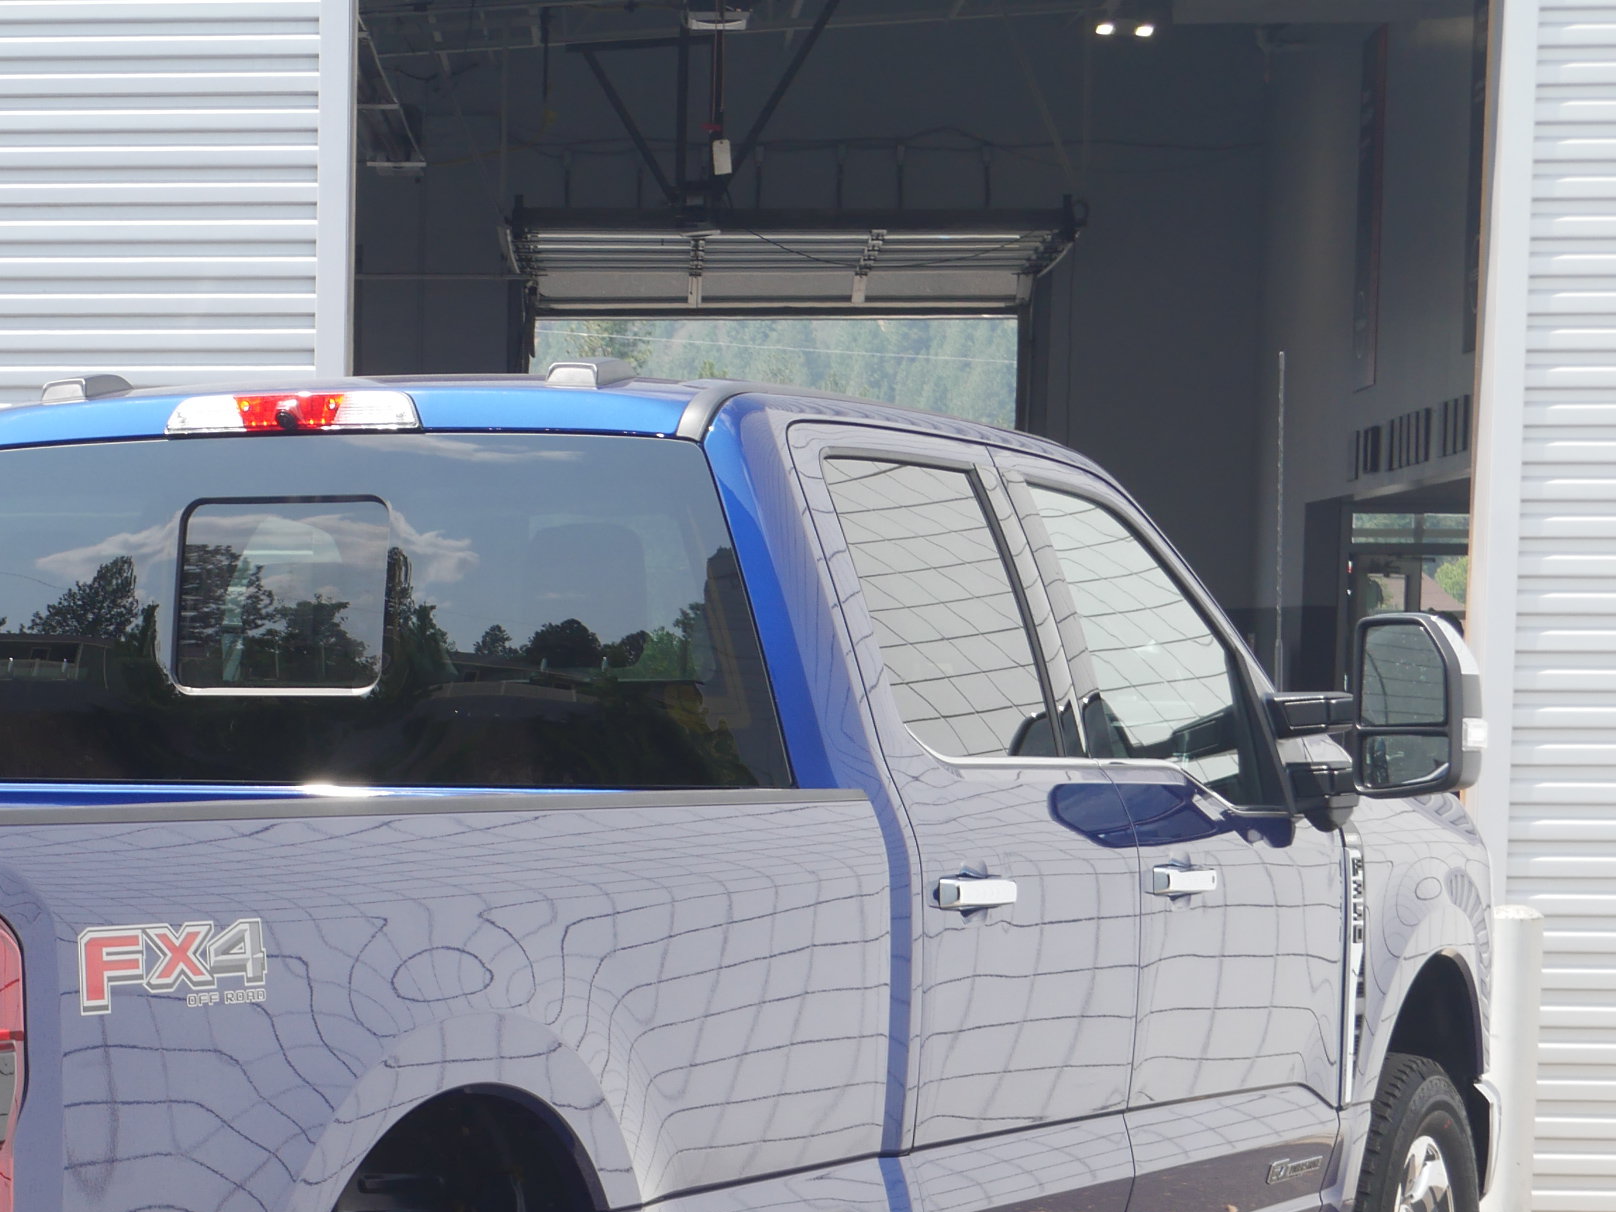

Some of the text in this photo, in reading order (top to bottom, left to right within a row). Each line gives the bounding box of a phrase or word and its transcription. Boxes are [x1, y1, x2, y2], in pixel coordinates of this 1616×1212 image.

[78, 918, 267, 1016] FX4
[186, 988, 267, 1008] OFF ROAD
